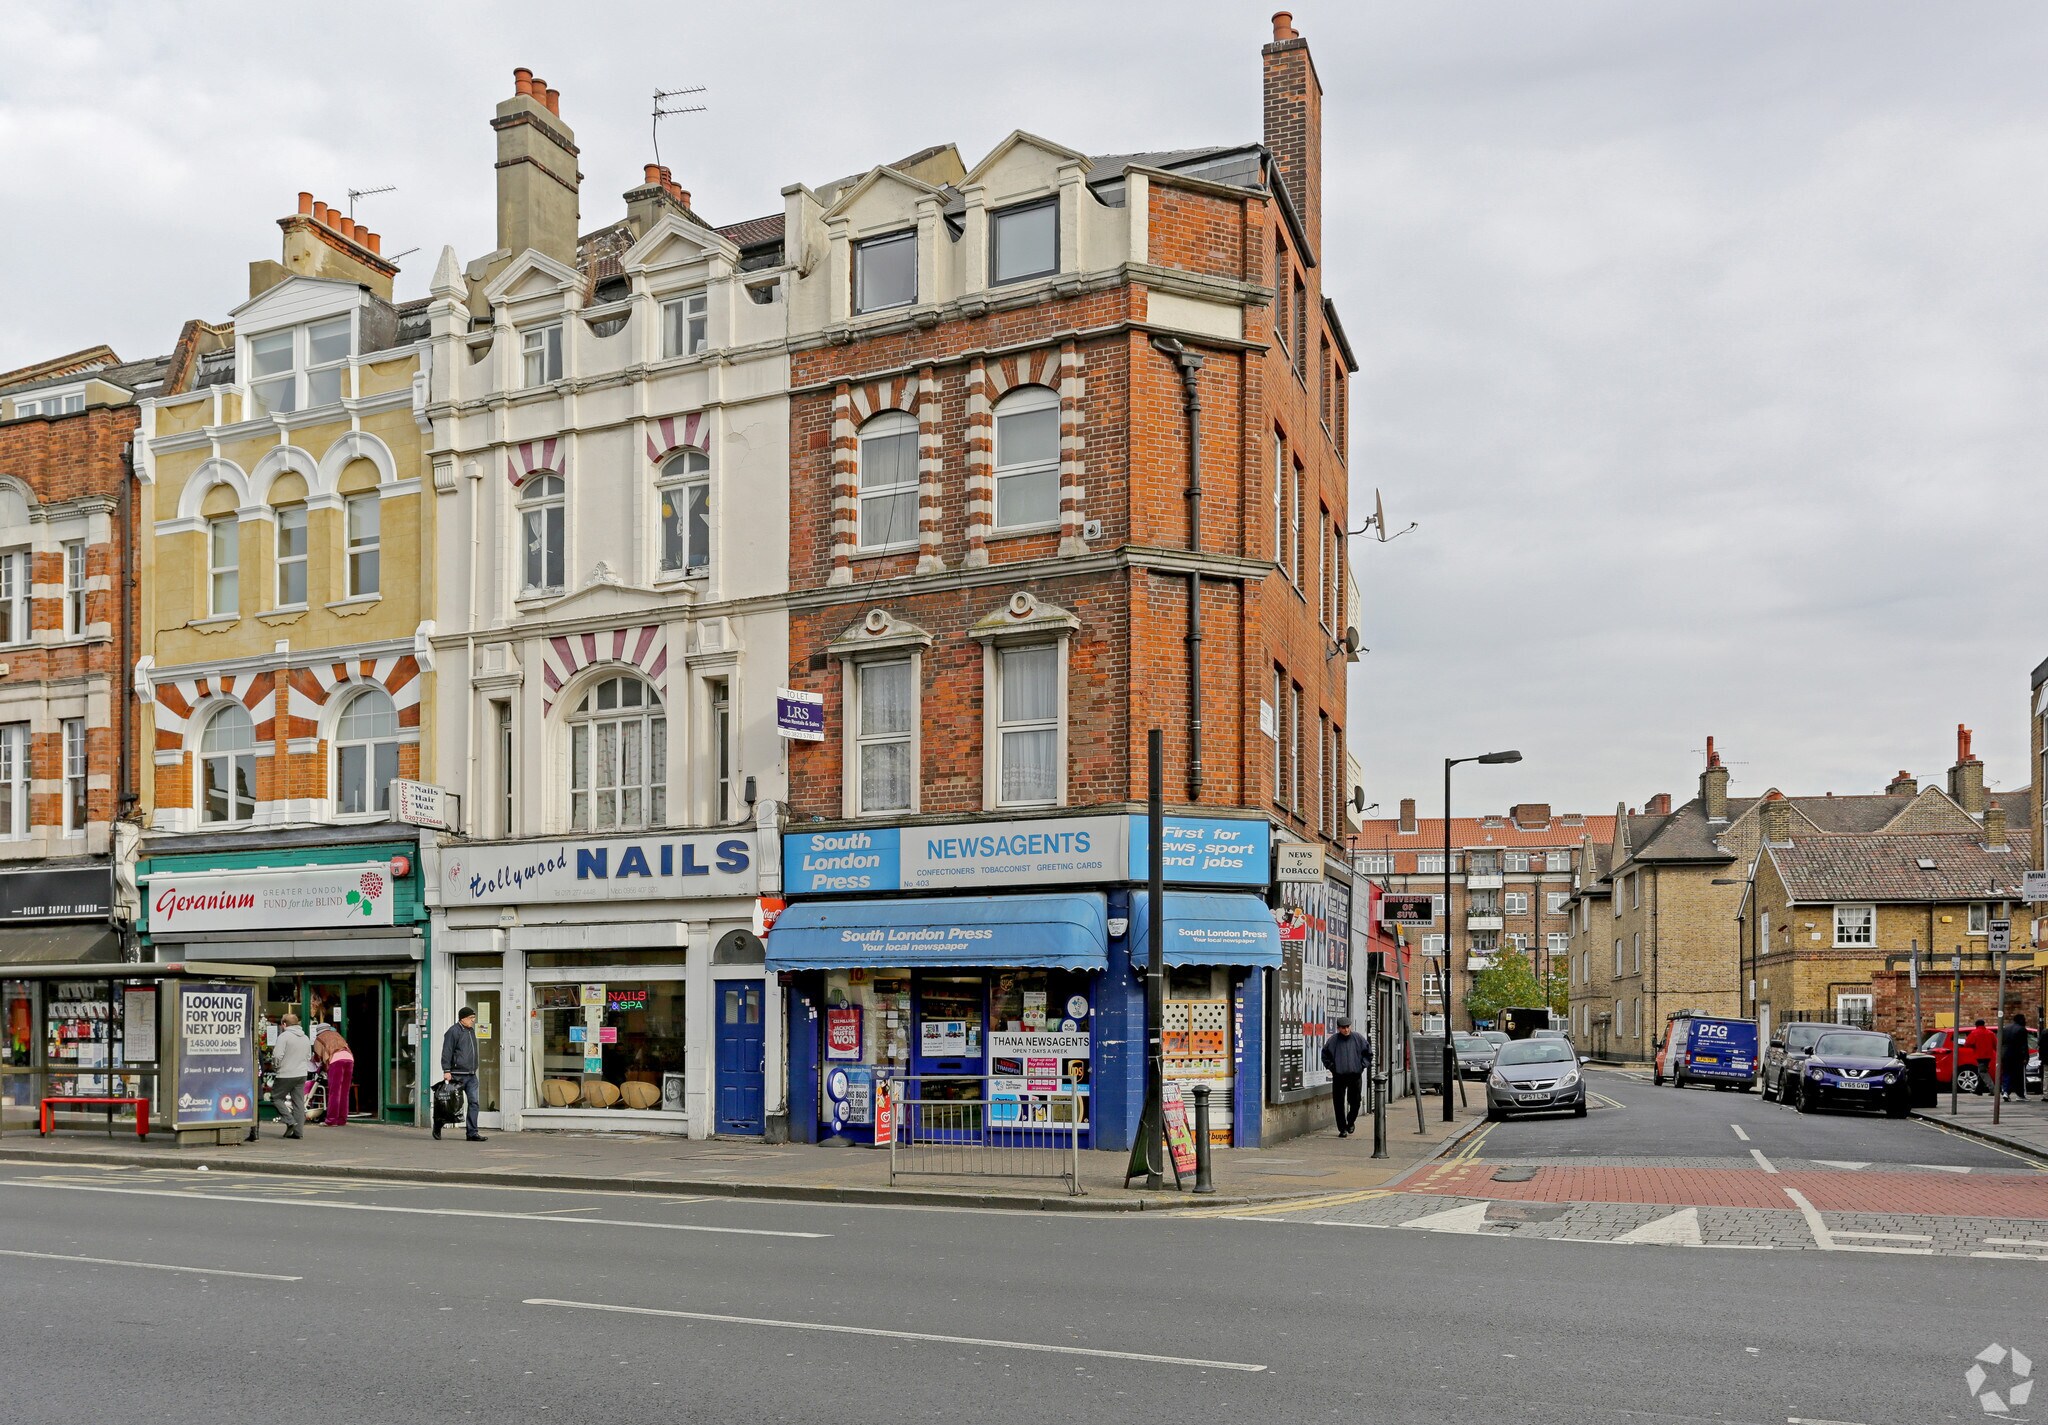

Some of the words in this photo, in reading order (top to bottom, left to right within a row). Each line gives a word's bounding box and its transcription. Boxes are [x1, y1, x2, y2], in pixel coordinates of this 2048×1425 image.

[786, 705, 809, 720] LRS
[415, 786, 438, 795] Nails
[415, 794, 435, 802] Hair
[415, 803, 434, 811] Wax
[1162, 826, 1204, 839] First
[1214, 829, 1240, 840] for
[810, 832, 871, 851] South
[927, 831, 1091, 859] NEWSAGENTS
[1162, 842, 1202, 854] ews,
[577, 840, 750, 880] NAILS
[802, 853, 879, 871] London
[1162, 856, 1195, 866] and
[1202, 856, 1243, 869] jobs
[470, 846, 568, 899] Hollywood
[917, 867, 975, 876] CONFECTIONERS
[981, 864, 1031, 874] TOBACCONIST
[1036, 862, 1074, 872] GREETING
[1076, 862, 1102, 870] CARDS
[812, 874, 870, 890] Press
[904, 880, 913, 888] No
[263, 888, 302, 896] GREATER
[307, 886, 343, 894] LONDON
[156, 888, 255, 921] Geranium
[264, 898, 287, 908] FUND
[288, 899, 300, 909] for
[301, 898, 313, 907] the
[315, 896, 342, 907] BLIND
[23, 906, 44, 915] BEAUTY
[49, 905, 71, 914] SUPPLY
[75, 904, 97, 913] LONDON
[841, 930, 885, 942] South
[888, 928, 945, 941] London
[948, 928, 992, 940] Press
[1178, 928, 1205, 936] South
[1208, 929, 1240, 937] London
[1242, 930, 1268, 938] Press
[862, 943, 884, 951] Your
[885, 943, 910, 951] local
[911, 943, 968, 951] newspaper
[608, 991, 646, 1001] NAILS
[186, 996, 243, 1009] LOOKING
[611, 1002, 619, 1010] &
[620, 1001, 643, 1009] SPA
[186, 1011, 208, 1022] FOR
[211, 1011, 242, 1022] YOUR
[186, 1024, 213, 1034] NEXT
[216, 1024, 241, 1034] JOB?
[1698, 1024, 1728, 1036] PFG
[834, 1036, 856, 1044] WON
[993, 1037, 1024, 1046] THANA
[1026, 1037, 1090, 1046] NEWSAGENTS
[1210, 1133, 1230, 1141] buyer
